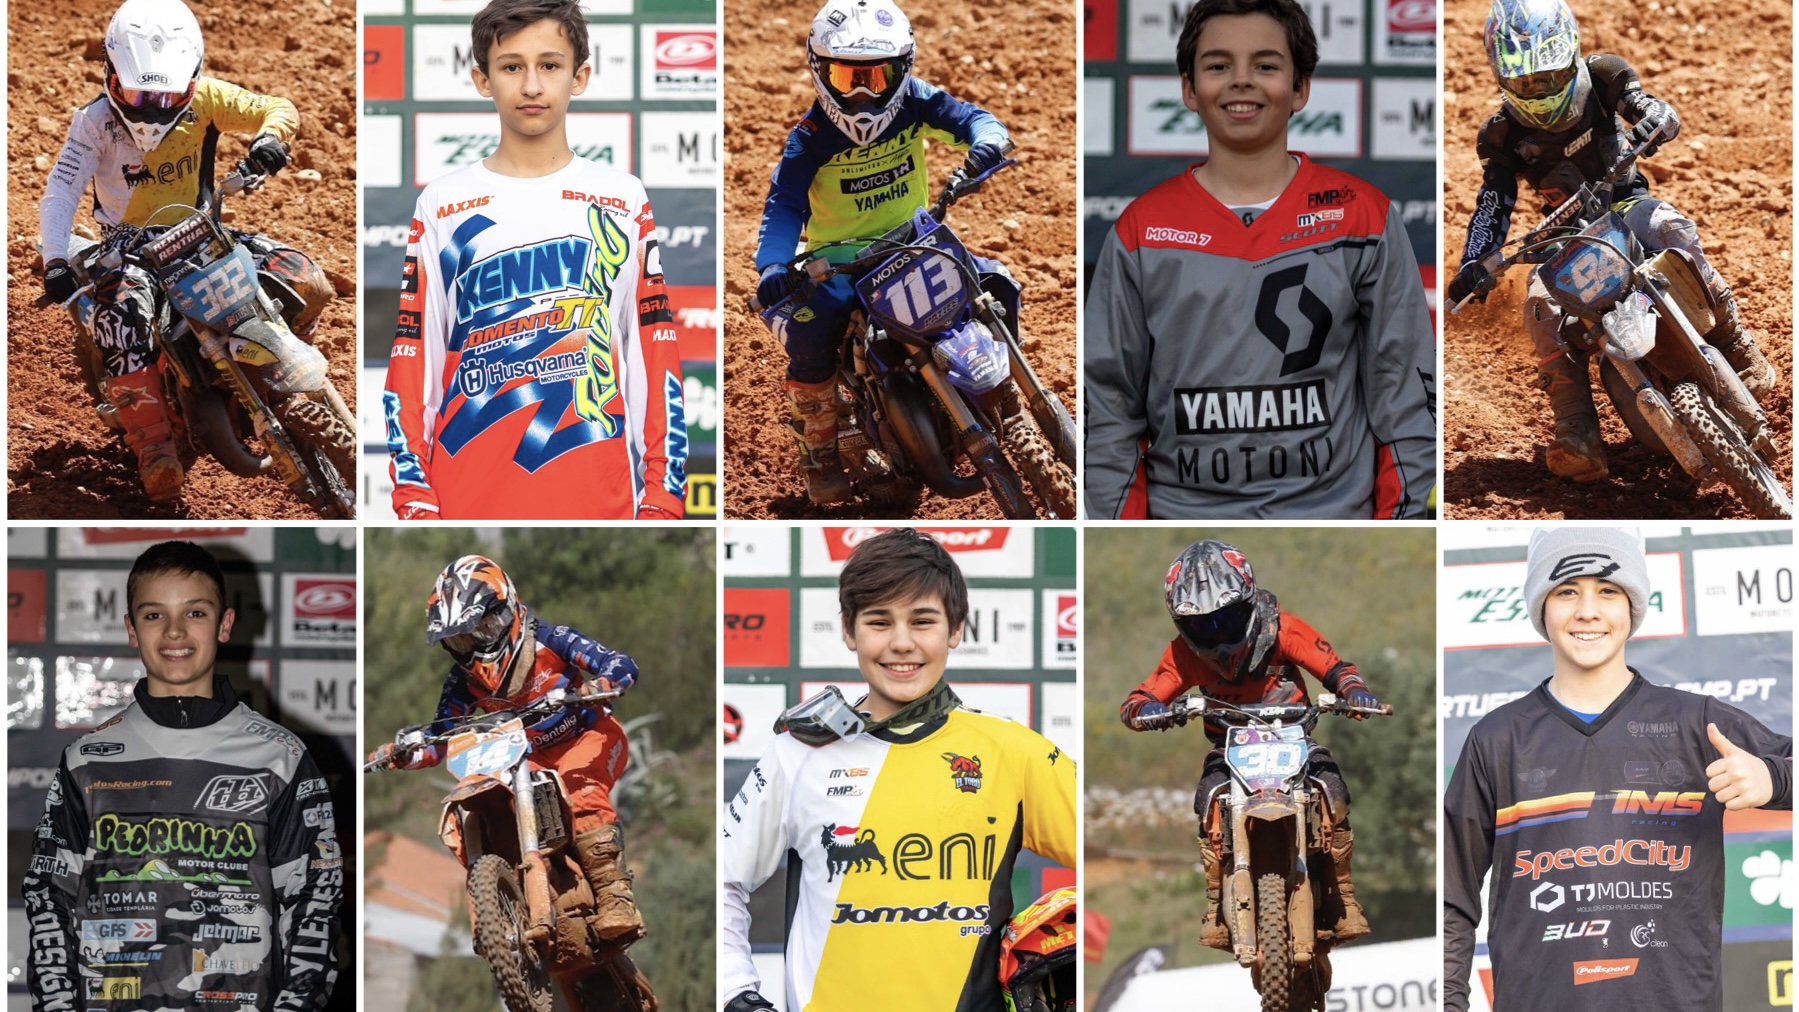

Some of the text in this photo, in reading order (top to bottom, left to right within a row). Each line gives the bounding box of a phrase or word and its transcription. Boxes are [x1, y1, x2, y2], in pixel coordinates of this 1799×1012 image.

[141, 74, 168, 84] SHOEI
[1564, 128, 1593, 157] LEATT
[157, 143, 198, 185] eni
[850, 172, 890, 192] MOTOS
[437, 195, 490, 220] MAXXIS
[562, 189, 631, 213] BRADOL
[854, 181, 909, 212] YAMAHA
[1308, 189, 1340, 209] FMP
[158, 224, 211, 260] RENTHAL
[1146, 226, 1212, 246] MOTOR 7
[457, 236, 592, 325] KENNY
[871, 253, 912, 287] MOTOS
[191, 256, 254, 322] 322
[885, 247, 963, 327] 113
[641, 299, 672, 314] BRA
[489, 351, 588, 384] Husqvarna
[541, 369, 589, 384] MOTORCYCLES
[1181, 385, 1325, 430] YAMAHA
[1177, 437, 1333, 485] MOTONI
[1737, 567, 1793, 607] MO
[724, 614, 766, 631] RO
[1639, 720, 1679, 733] YAMAHA
[1236, 743, 1303, 778] 30
[826, 785, 854, 797] FMP
[956, 777, 963, 788] EL
[892, 815, 997, 881] eni
[1512, 838, 1692, 880] SpeedCity
[178, 858, 249, 871] MOTOR CLUBE
[104, 891, 158, 905] TOMAR
[831, 901, 991, 925] Jomotos
[960, 925, 992, 938] grupo
[1650, 939, 1668, 948] clean
[106, 951, 162, 962] MICHELIN
[110, 976, 139, 1000] eni
